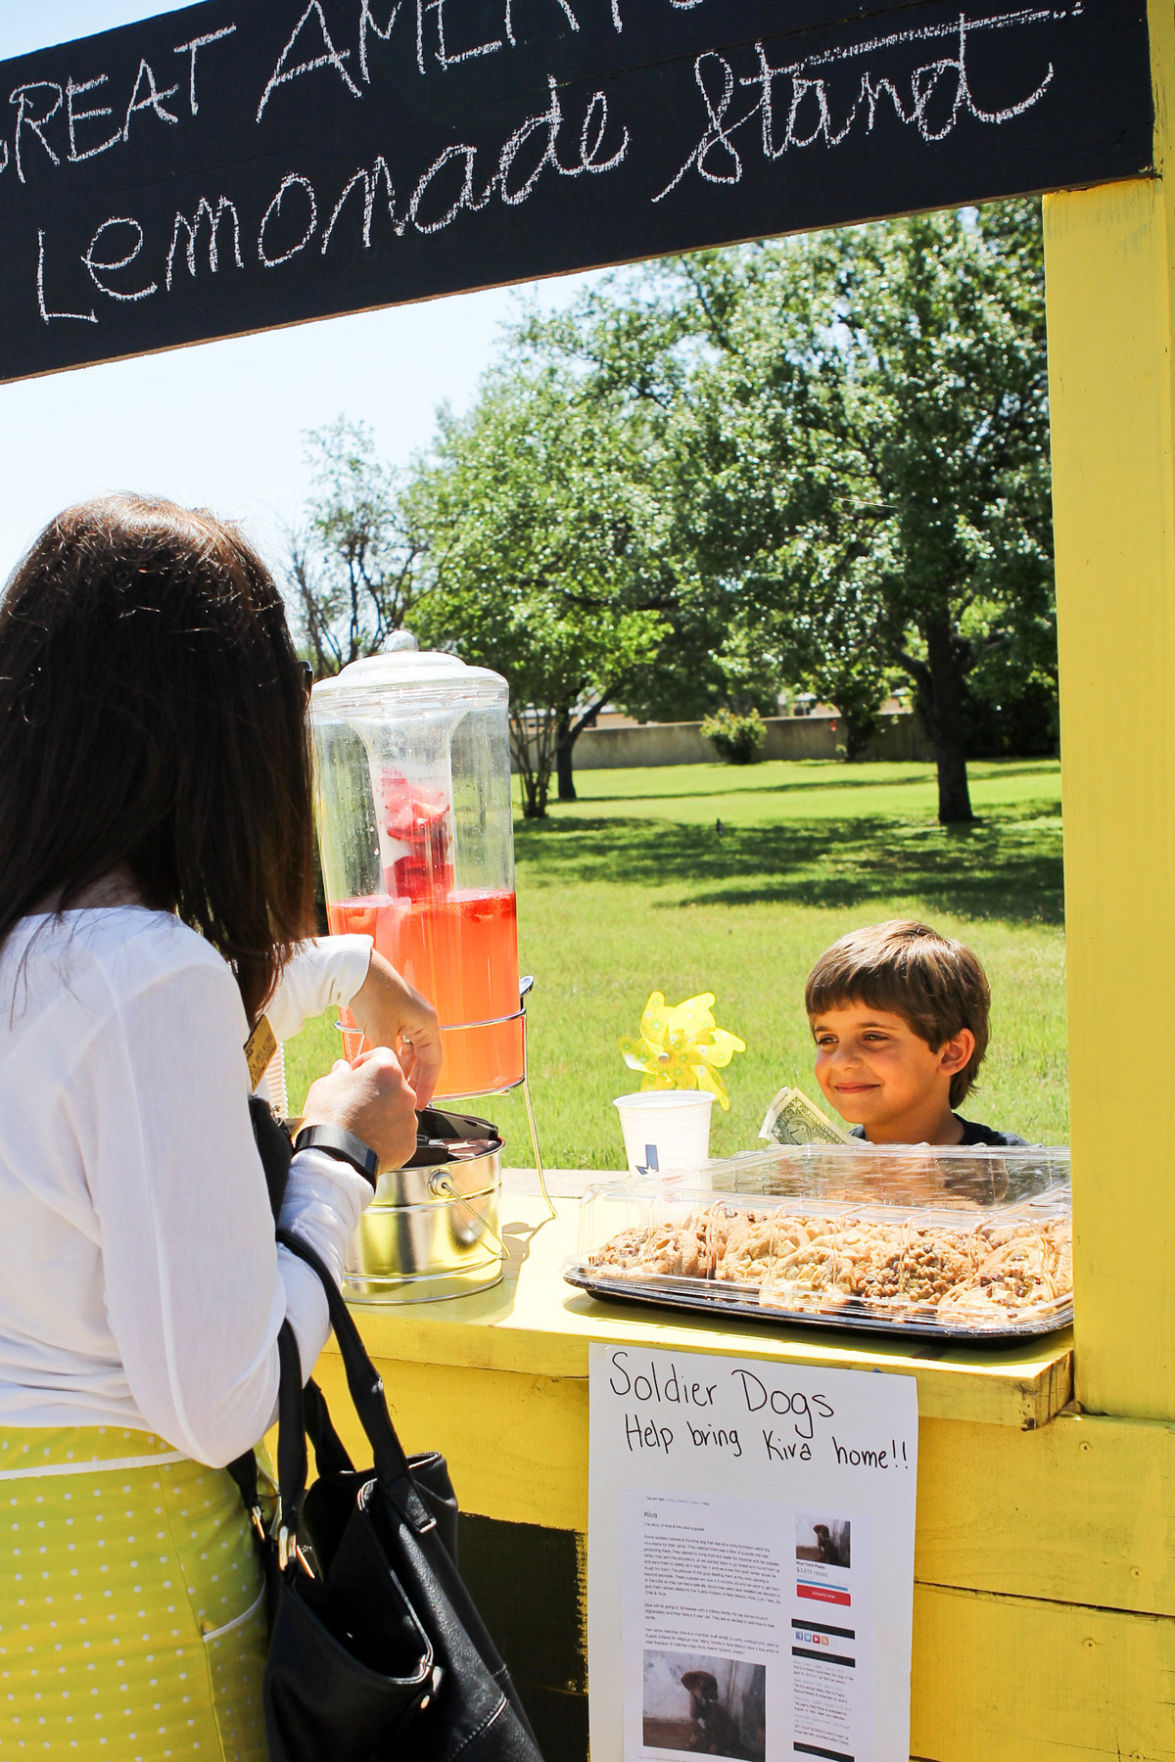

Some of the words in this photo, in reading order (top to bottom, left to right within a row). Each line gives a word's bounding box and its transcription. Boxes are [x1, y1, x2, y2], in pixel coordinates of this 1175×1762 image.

[0, 22, 237, 184] REAT
[37, 74, 631, 325] Lemonade
[650, 5, 1083, 204] Stand
[610, 1351, 718, 1408] Soldier
[731, 1368, 835, 1440] Dogs
[625, 1413, 674, 1454] Help
[686, 1420, 743, 1458] bring
[762, 1430, 813, 1462] Kiva
[832, 1435, 909, 1470] home!!
